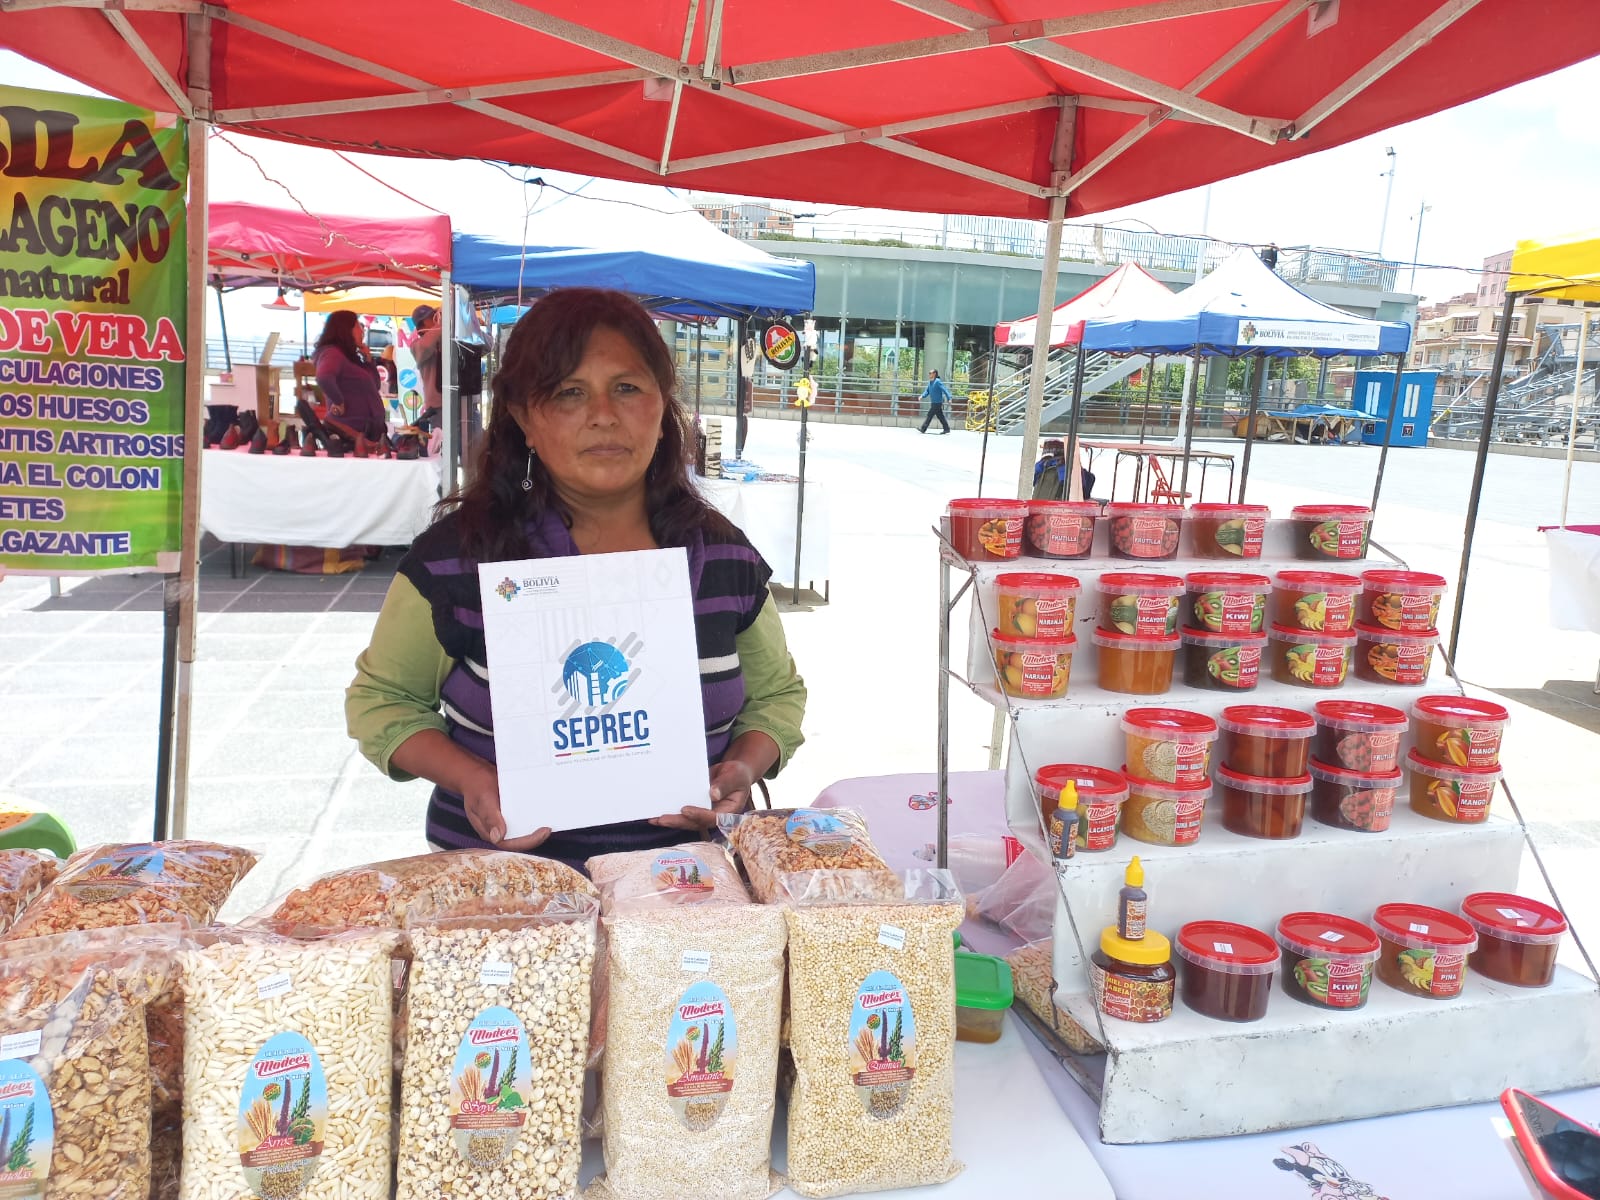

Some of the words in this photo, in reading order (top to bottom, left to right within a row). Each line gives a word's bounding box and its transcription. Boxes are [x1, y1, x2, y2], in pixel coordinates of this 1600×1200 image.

[0, 105, 181, 190] ILA
[0, 265, 130, 304] natural
[53, 312, 186, 361] VERA
[771, 336, 793, 355] BOLIVIA
[0, 359, 163, 391] CULACIONES
[38, 396, 148, 424] HUESOS
[0, 428, 54, 453] ITIS
[57, 431, 184, 458] ARTROSIS
[27, 463, 61, 487] EL
[66, 465, 160, 489] COLON
[0, 530, 130, 555] GAZANTE
[1051, 534, 1078, 542] FRUTILLA
[1134, 537, 1161, 545] FRUTILLA
[523, 577, 560, 587] BOLIVIA
[1039, 618, 1064, 626] NARANJA
[1024, 672, 1051, 681] NARANJA
[552, 709, 649, 750] SEPREC
[1460, 798, 1486, 806] MANGO
[1106, 977, 1121, 987] MIEL
[1332, 983, 1358, 991] KIWI
